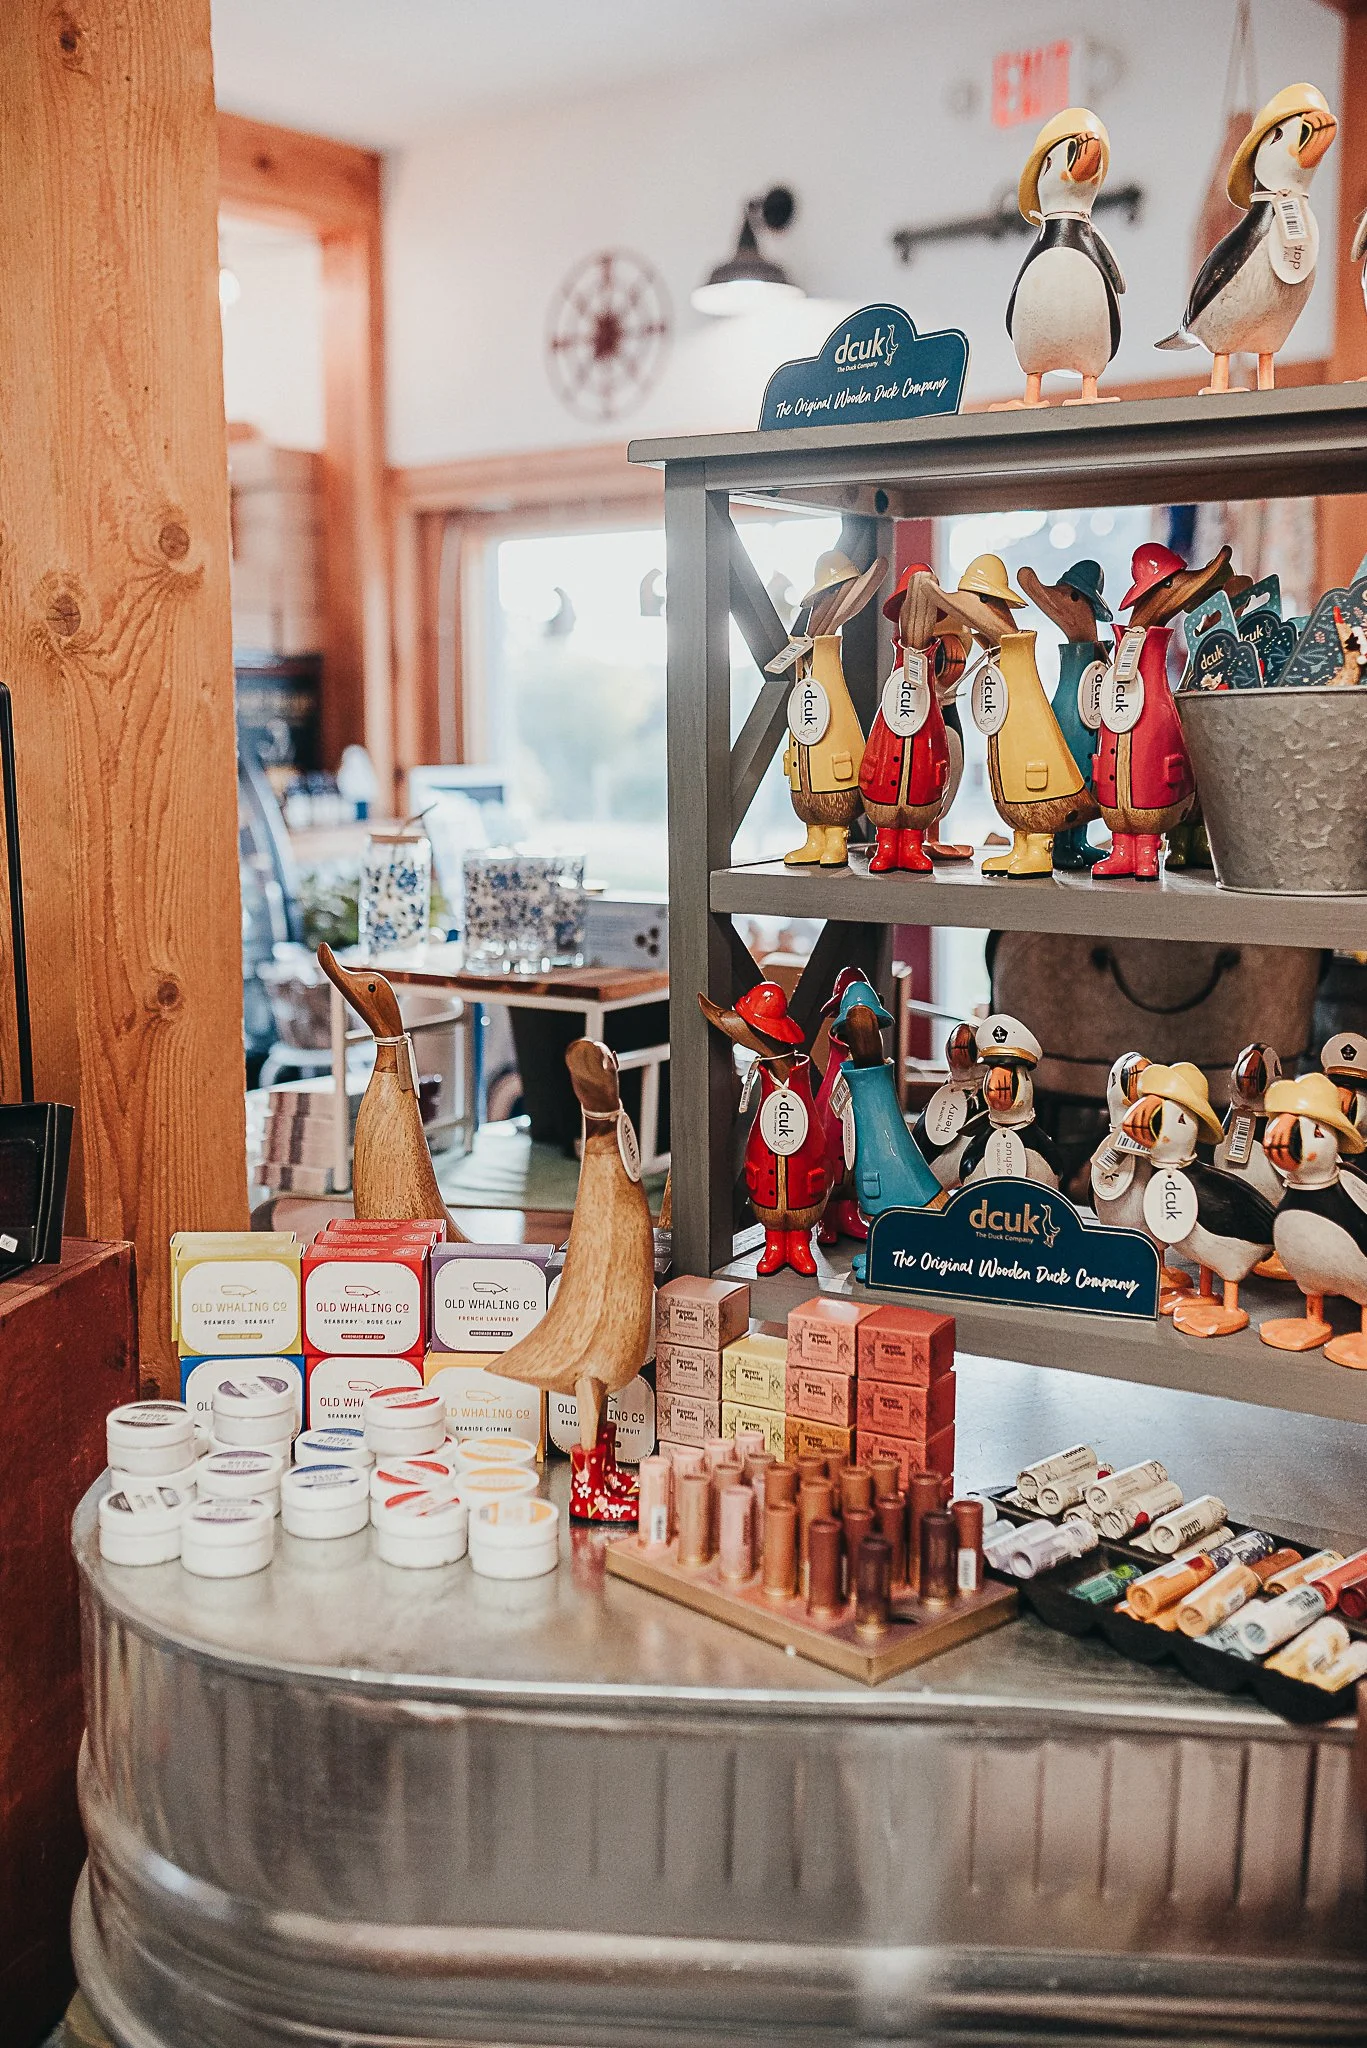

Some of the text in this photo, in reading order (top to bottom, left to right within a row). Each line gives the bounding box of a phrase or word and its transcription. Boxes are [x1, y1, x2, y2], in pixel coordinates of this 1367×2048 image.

[835, 327, 886, 364] dcuk
[845, 363, 857, 371] Duck
[857, 361, 878, 369] Company
[776, 377, 949, 418] The Original Wooden Duck Company
[1200, 644, 1225, 670] dcuk
[900, 680, 917, 718] dcuk
[984, 675, 997, 714] dcuk
[804, 690, 818, 726] dcuk
[779, 1102, 795, 1138] dcuk
[940, 1103, 959, 1133] henry
[1003, 1142, 1013, 1175] oshua
[1165, 1181, 1182, 1220] dcuk
[969, 1199, 1040, 1235] dcuk
[1005, 1235, 1034, 1244] Company
[892, 1250, 1140, 1298] The Original Wooden Duck Company
[192, 1303, 213, 1313] OLD
[216, 1302, 270, 1313] WHALING
[316, 1302, 337, 1313] OLD
[340, 1302, 392, 1313] WHALING
[445, 1299, 465, 1309] OLD
[468, 1299, 520, 1310] WHALING
[676, 1308, 694, 1317] poppy
[676, 1358, 694, 1366] poppy
[741, 1368, 760, 1376] poppy
[196, 1401, 213, 1411] OL
[320, 1397, 340, 1407] OLD
[445, 1407, 458, 1418] LD
[461, 1407, 512, 1419] WHALING
[557, 1403, 577, 1415] OLD
[676, 1408, 694, 1416] poppy
[561, 1419, 580, 1427] BERG
[618, 1426, 641, 1435] EFRUIT
[1179, 1518, 1201, 1537] poppy
